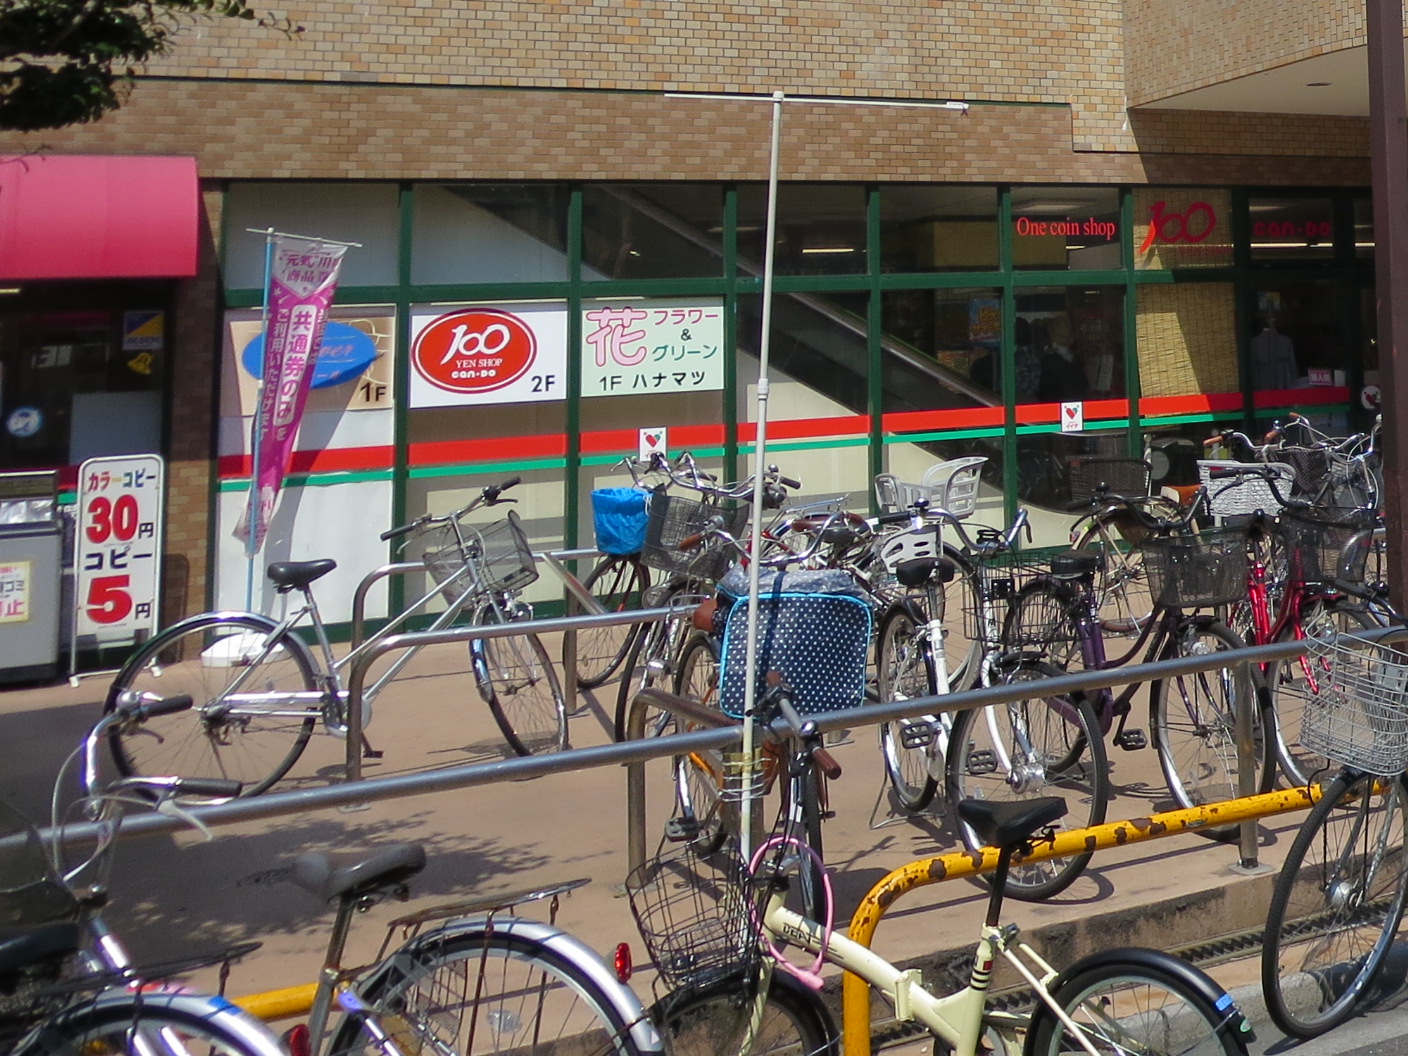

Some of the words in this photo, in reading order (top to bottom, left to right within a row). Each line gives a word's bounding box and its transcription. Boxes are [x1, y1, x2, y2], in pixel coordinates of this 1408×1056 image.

[1016, 216, 1047, 237] One
[1049, 216, 1079, 237] coin
[1083, 216, 1116, 241] shop
[1137, 201, 1217, 255] 100
[653, 308, 719, 326] フラワー
[440, 323, 511, 365] 100
[586, 305, 648, 367] 花
[680, 328, 693, 341] &
[455, 358, 476, 369] YEN
[478, 357, 503, 369] SHOP
[651, 344, 719, 362] グリーン
[530, 375, 556, 393] 2F
[599, 374, 623, 392] 1F
[632, 370, 706, 390] ハナマツ
[359, 382, 387, 403] 1F
[87, 468, 157, 493] カラーコピー
[84, 546, 153, 571] コピー
